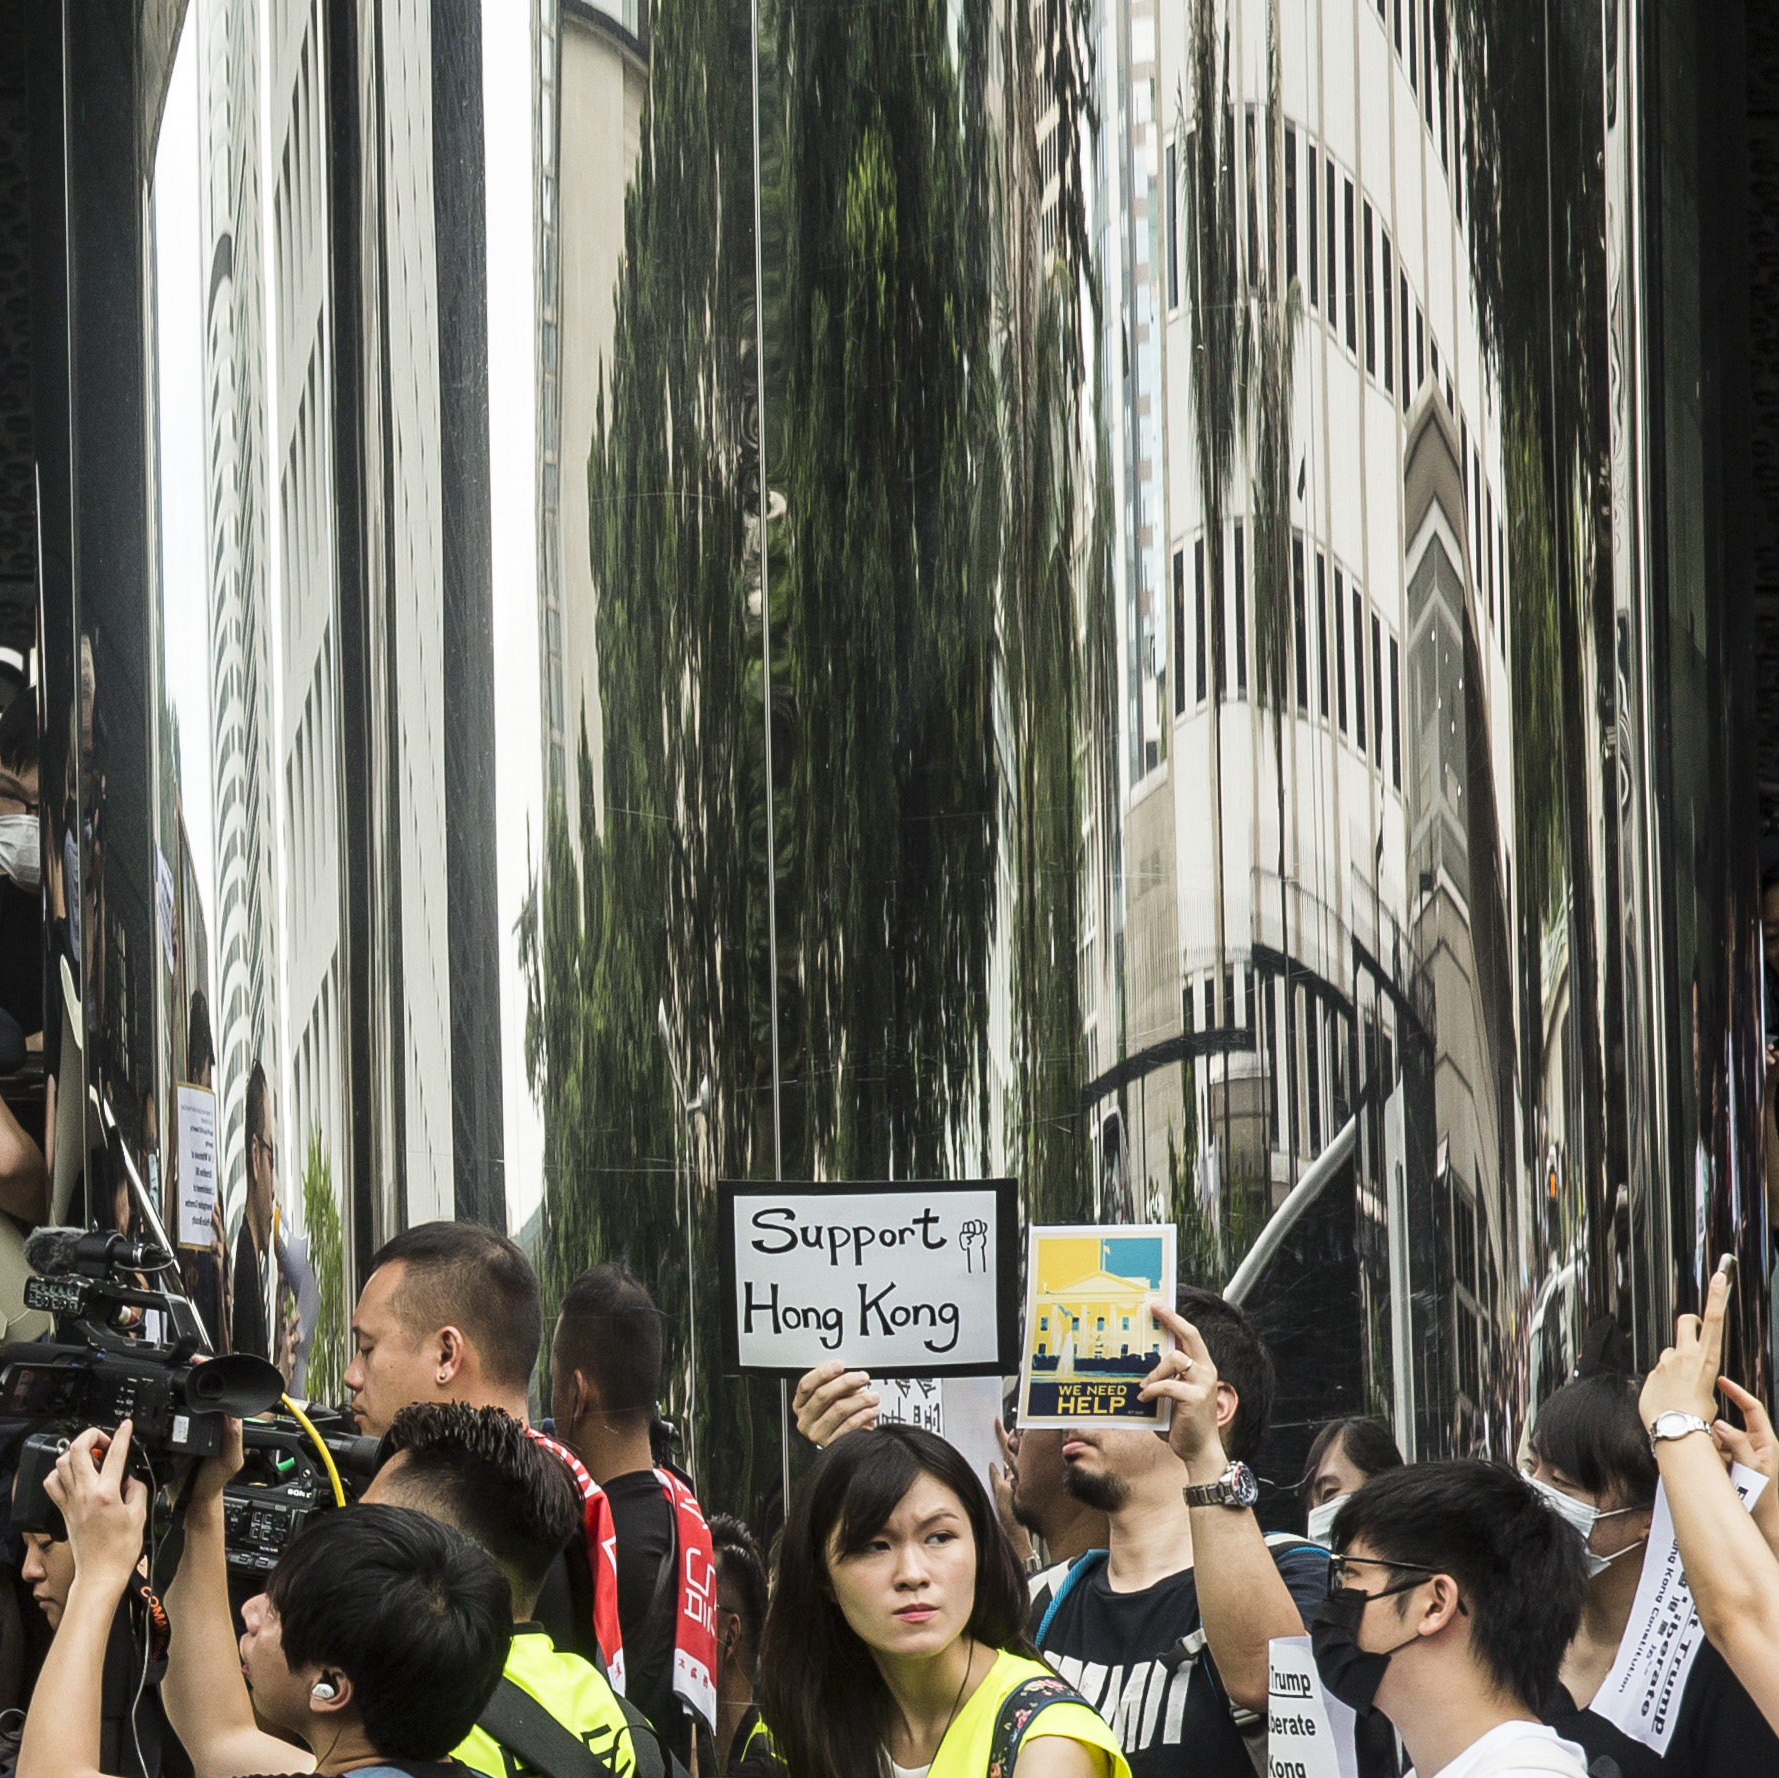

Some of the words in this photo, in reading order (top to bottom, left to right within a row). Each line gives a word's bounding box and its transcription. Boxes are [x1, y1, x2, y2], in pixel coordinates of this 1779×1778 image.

[751, 1207, 948, 1266] Support
[743, 1280, 844, 1350] Hong
[856, 1280, 960, 1353] Kong
[1056, 1396, 1127, 1415] HELP
[1058, 1384, 1083, 1396] WE
[1086, 1384, 1127, 1396] NEED
[1654, 1567, 1676, 1604] Kong
[1618, 1606, 1661, 1694] Constitution
[1650, 1638, 1693, 1736] Trump
[1269, 1713, 1317, 1737] berate
